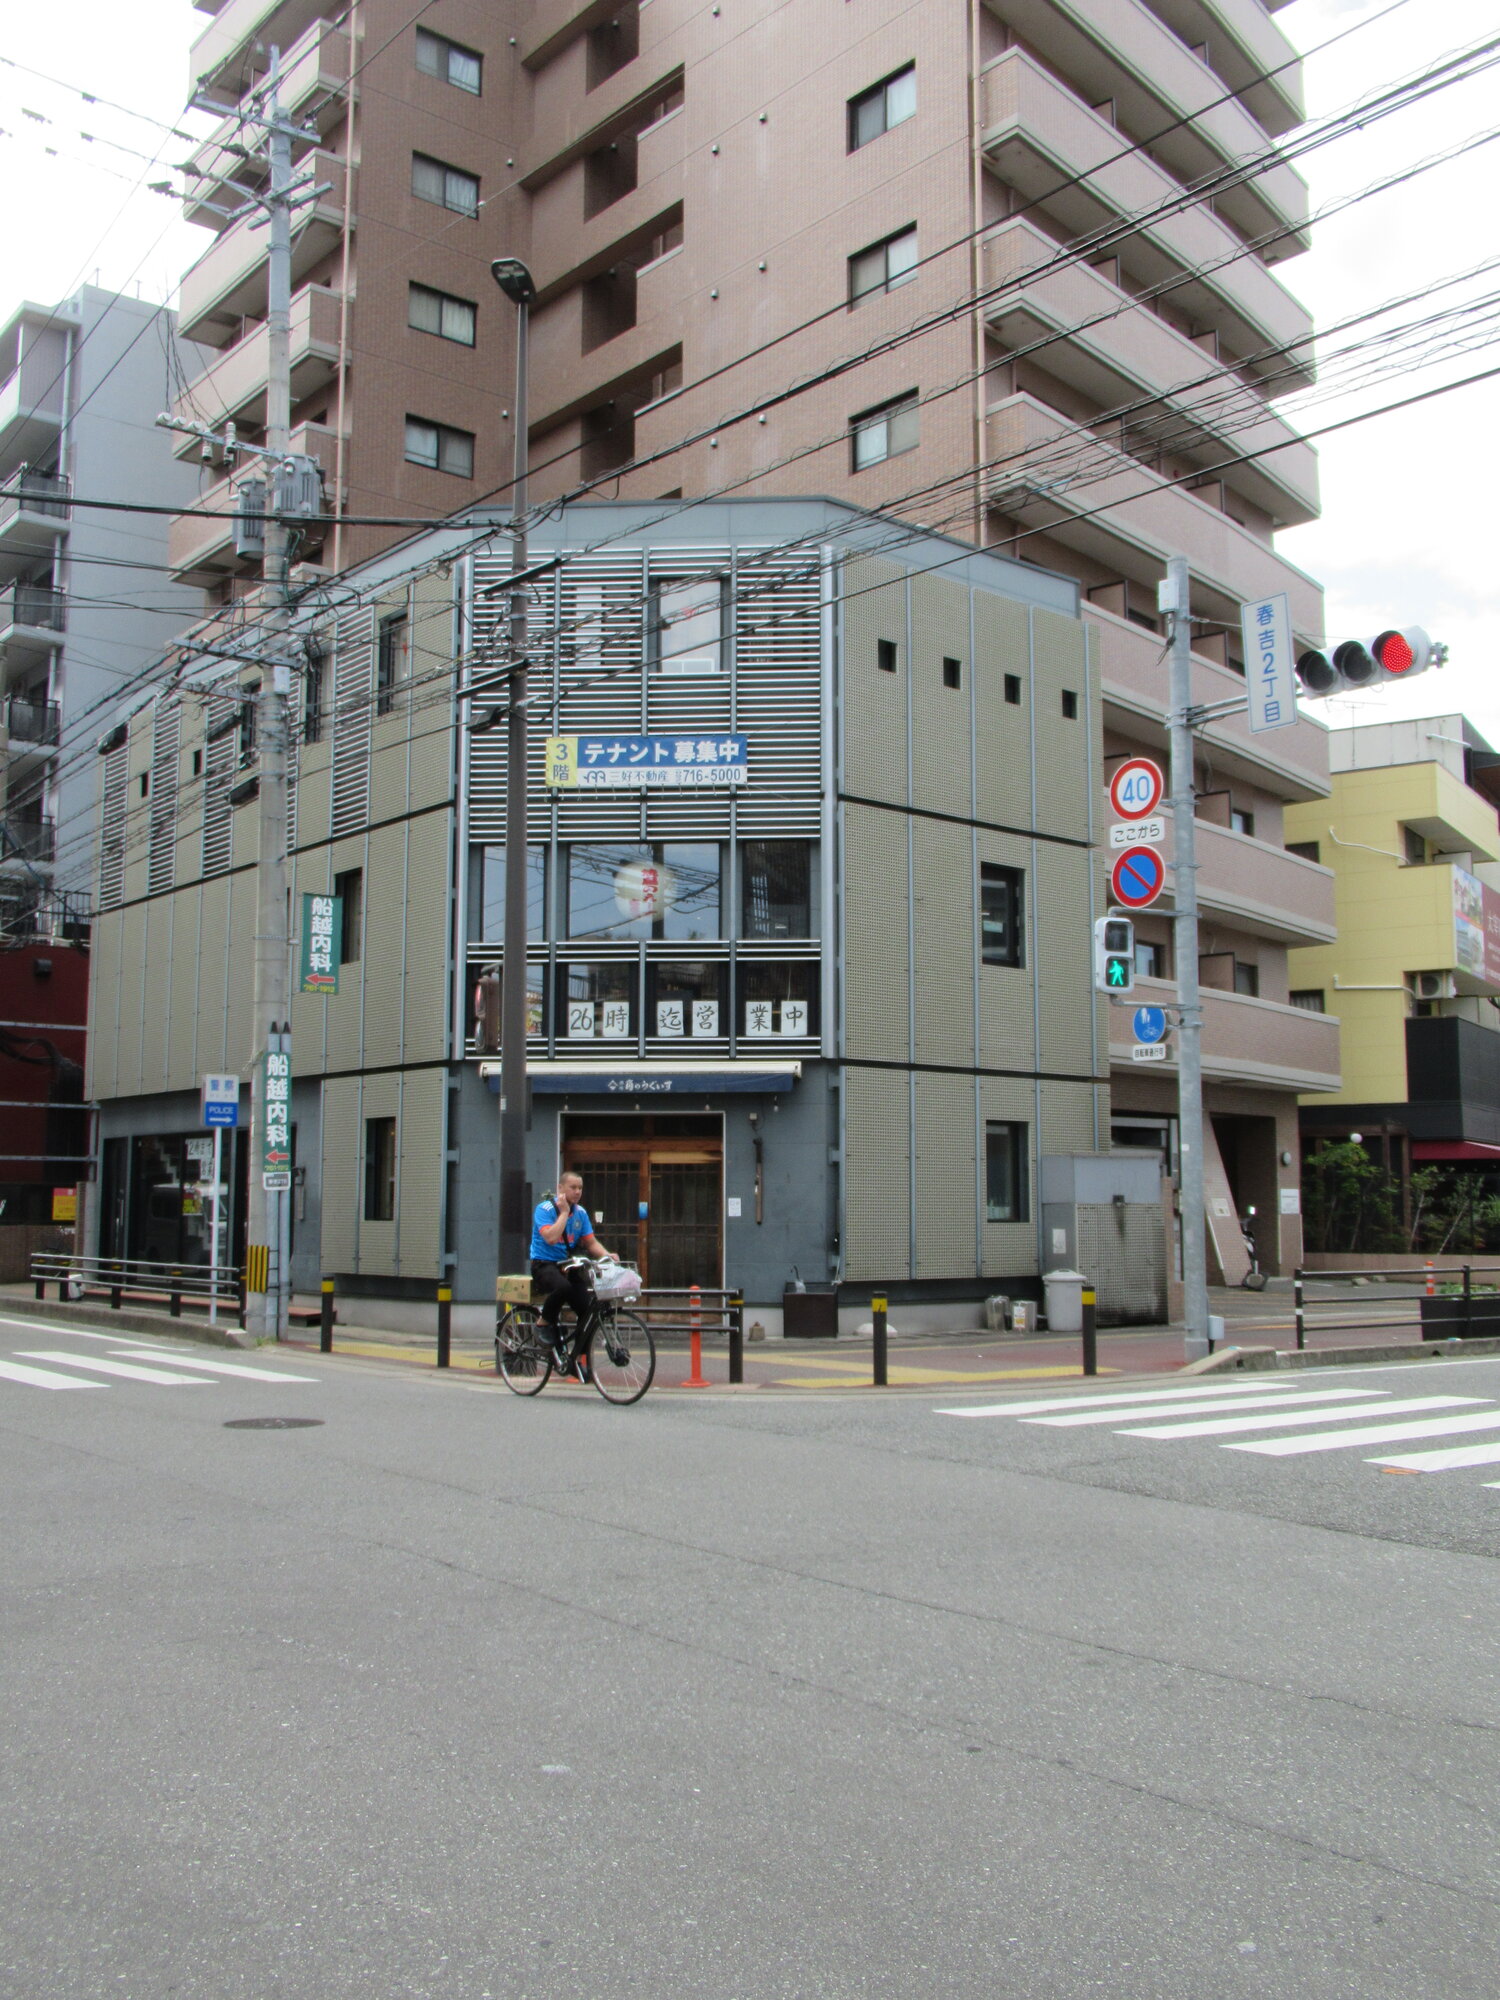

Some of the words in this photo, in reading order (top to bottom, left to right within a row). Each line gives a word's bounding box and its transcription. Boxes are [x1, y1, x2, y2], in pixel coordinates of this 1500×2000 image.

[1256, 604, 1281, 723] 春吉2丁目
[553, 743, 569, 781] 3階
[584, 740, 740, 764] テナント募集中
[609, 770, 668, 782] 三好不動産
[683, 768, 741, 782] 716-5000
[1123, 775, 1150, 803] 40
[1114, 824, 1160, 843] ここから
[310, 896, 334, 973] 船越内科
[570, 1004, 803, 1033] 26時迄営業中
[208, 1106, 234, 1114] POLICE
[266, 1054, 289, 1147] 船越内科
